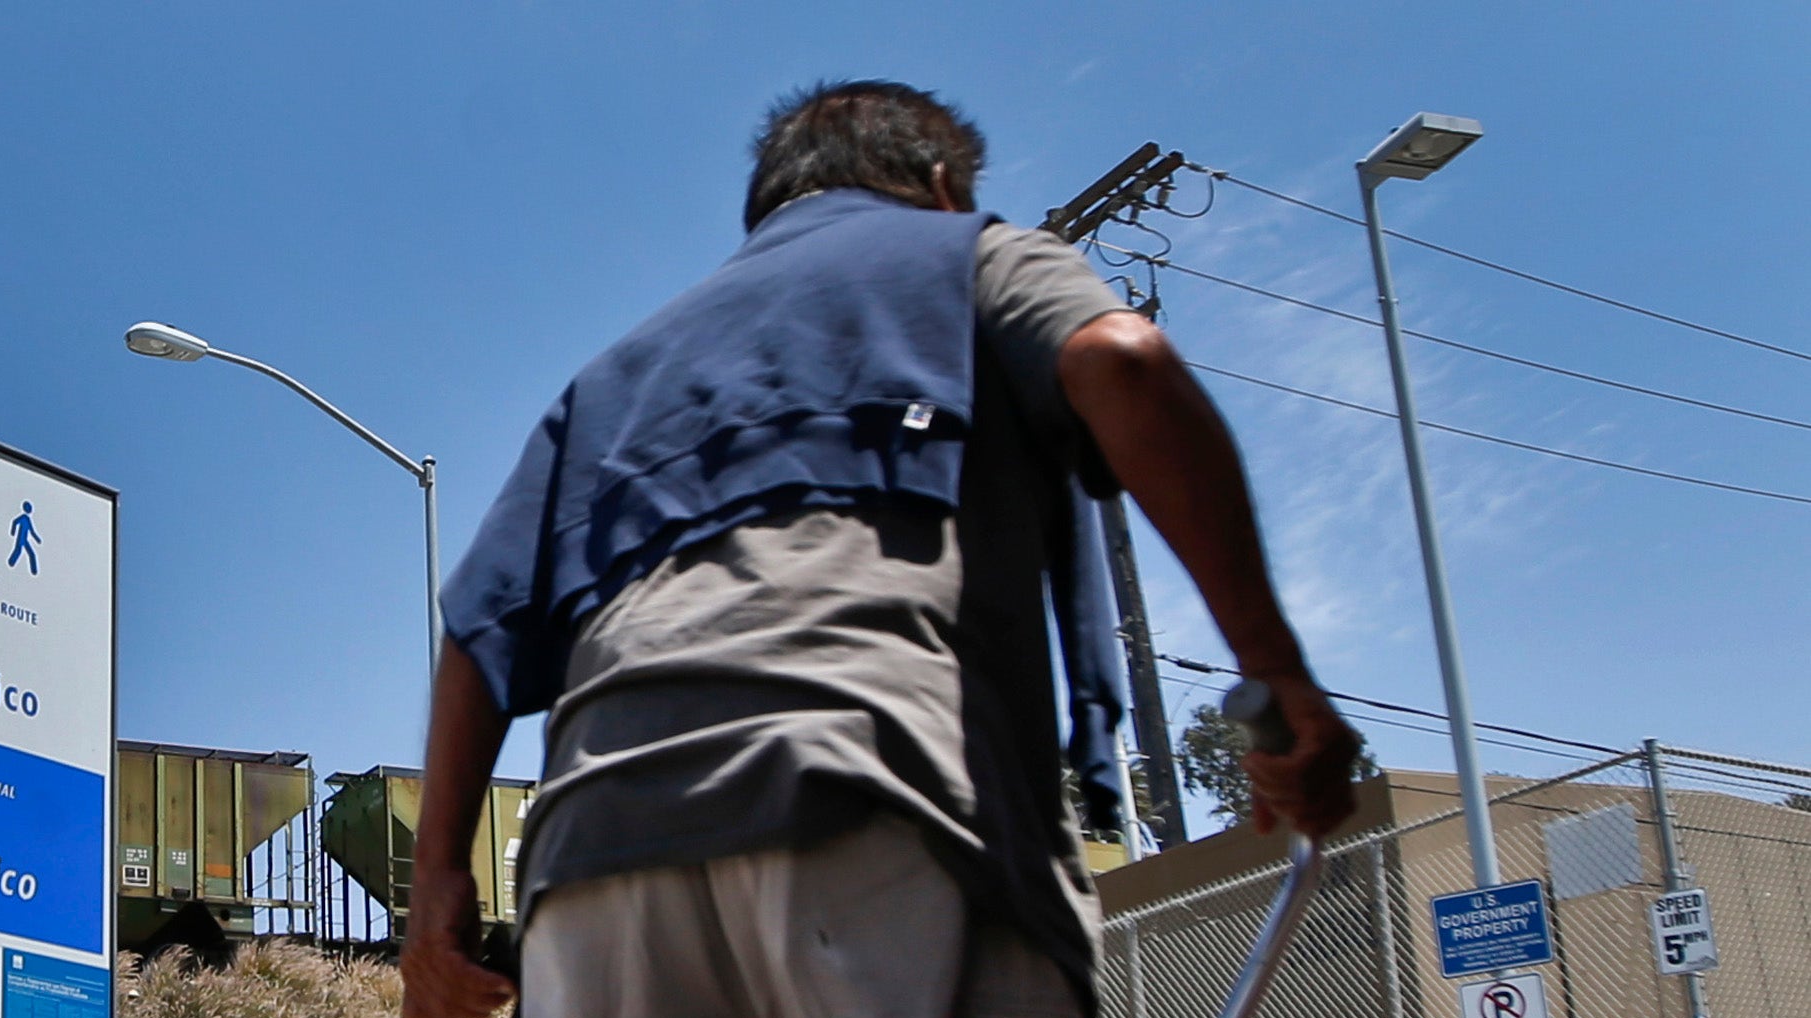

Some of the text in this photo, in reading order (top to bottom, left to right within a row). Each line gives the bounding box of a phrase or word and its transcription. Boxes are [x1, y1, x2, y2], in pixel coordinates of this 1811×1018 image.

[0, 602, 38, 625] ROUTE
[1471, 894, 1501, 909] U.S.
[1656, 894, 1702, 912] SPEED
[1440, 901, 1539, 929] GOVERNMENT
[1660, 910, 1700, 928] LIMIT
[1452, 918, 1529, 941] PROPERTY
[1664, 930, 1710, 965] 5 MPH
